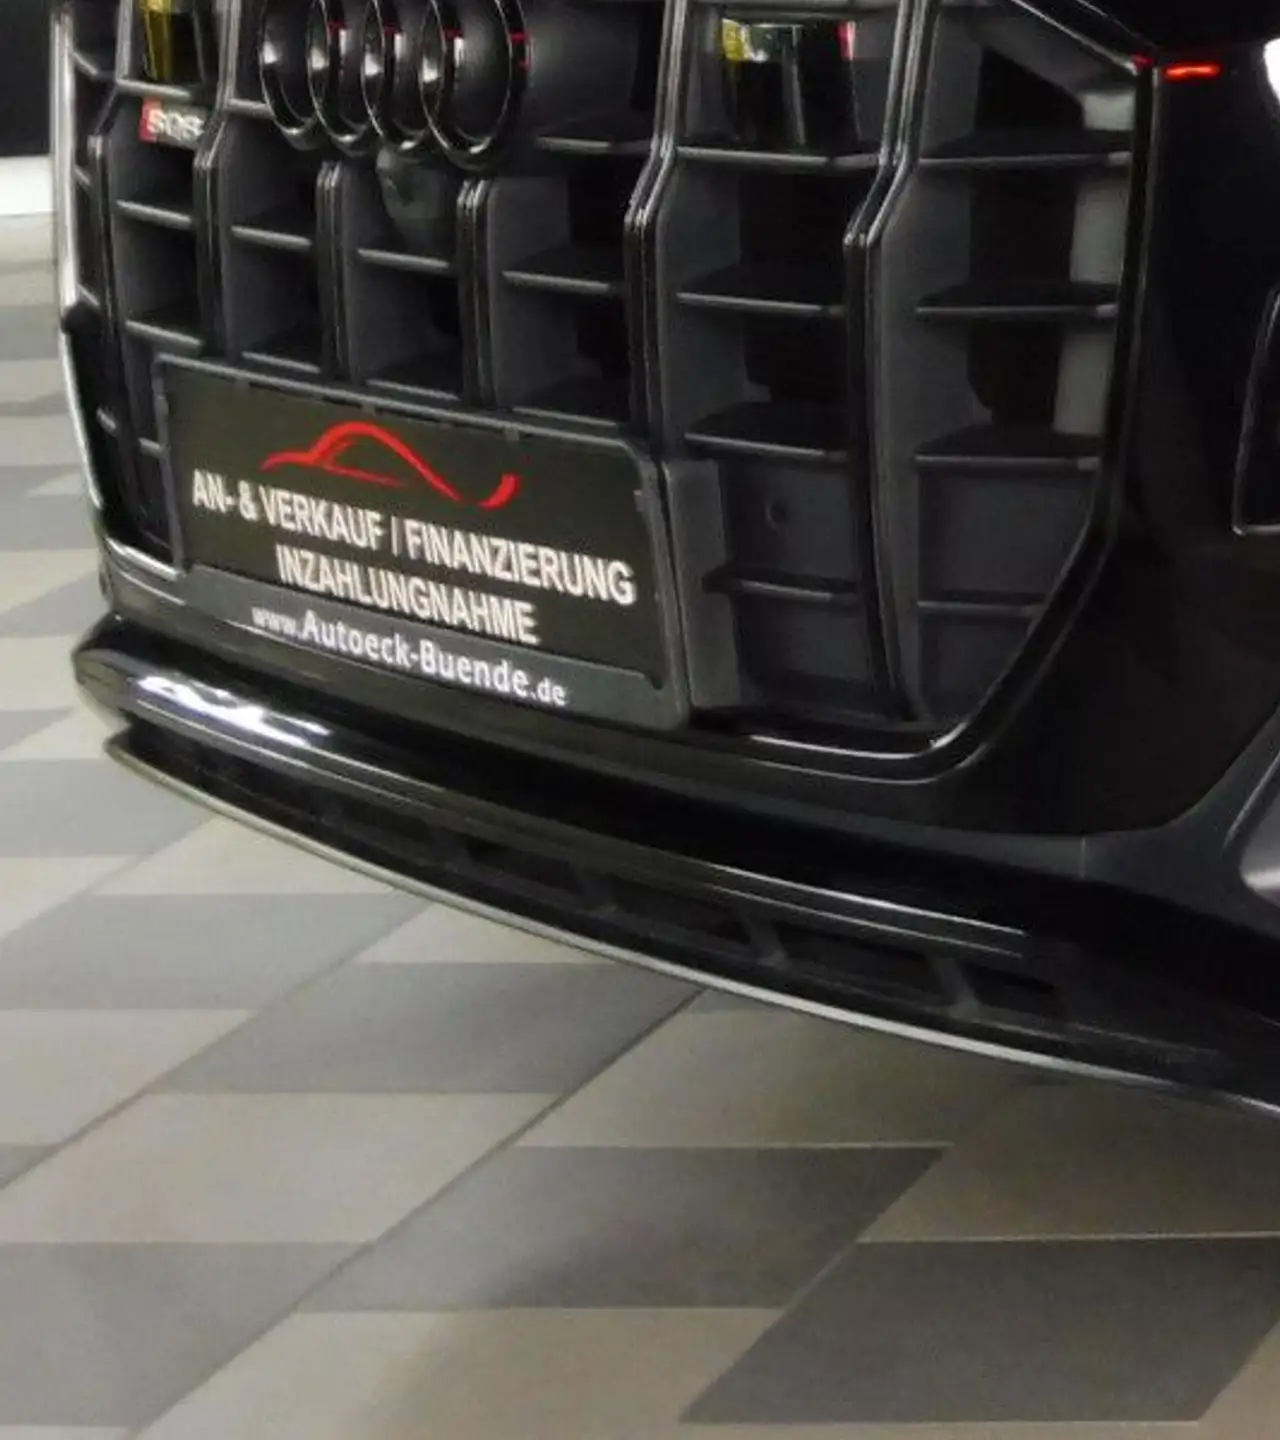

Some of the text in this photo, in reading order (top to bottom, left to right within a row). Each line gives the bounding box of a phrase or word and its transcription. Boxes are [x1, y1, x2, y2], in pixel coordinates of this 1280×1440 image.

[191, 468, 233, 513] AN-
[238, 486, 260, 522] &
[260, 485, 384, 551] VERKAUF
[405, 521, 637, 606] FINANZIERUNG
[274, 544, 542, 645] INZAHLUNGNAHME
[251, 605, 568, 707] www.Autoeck-Buende.de
